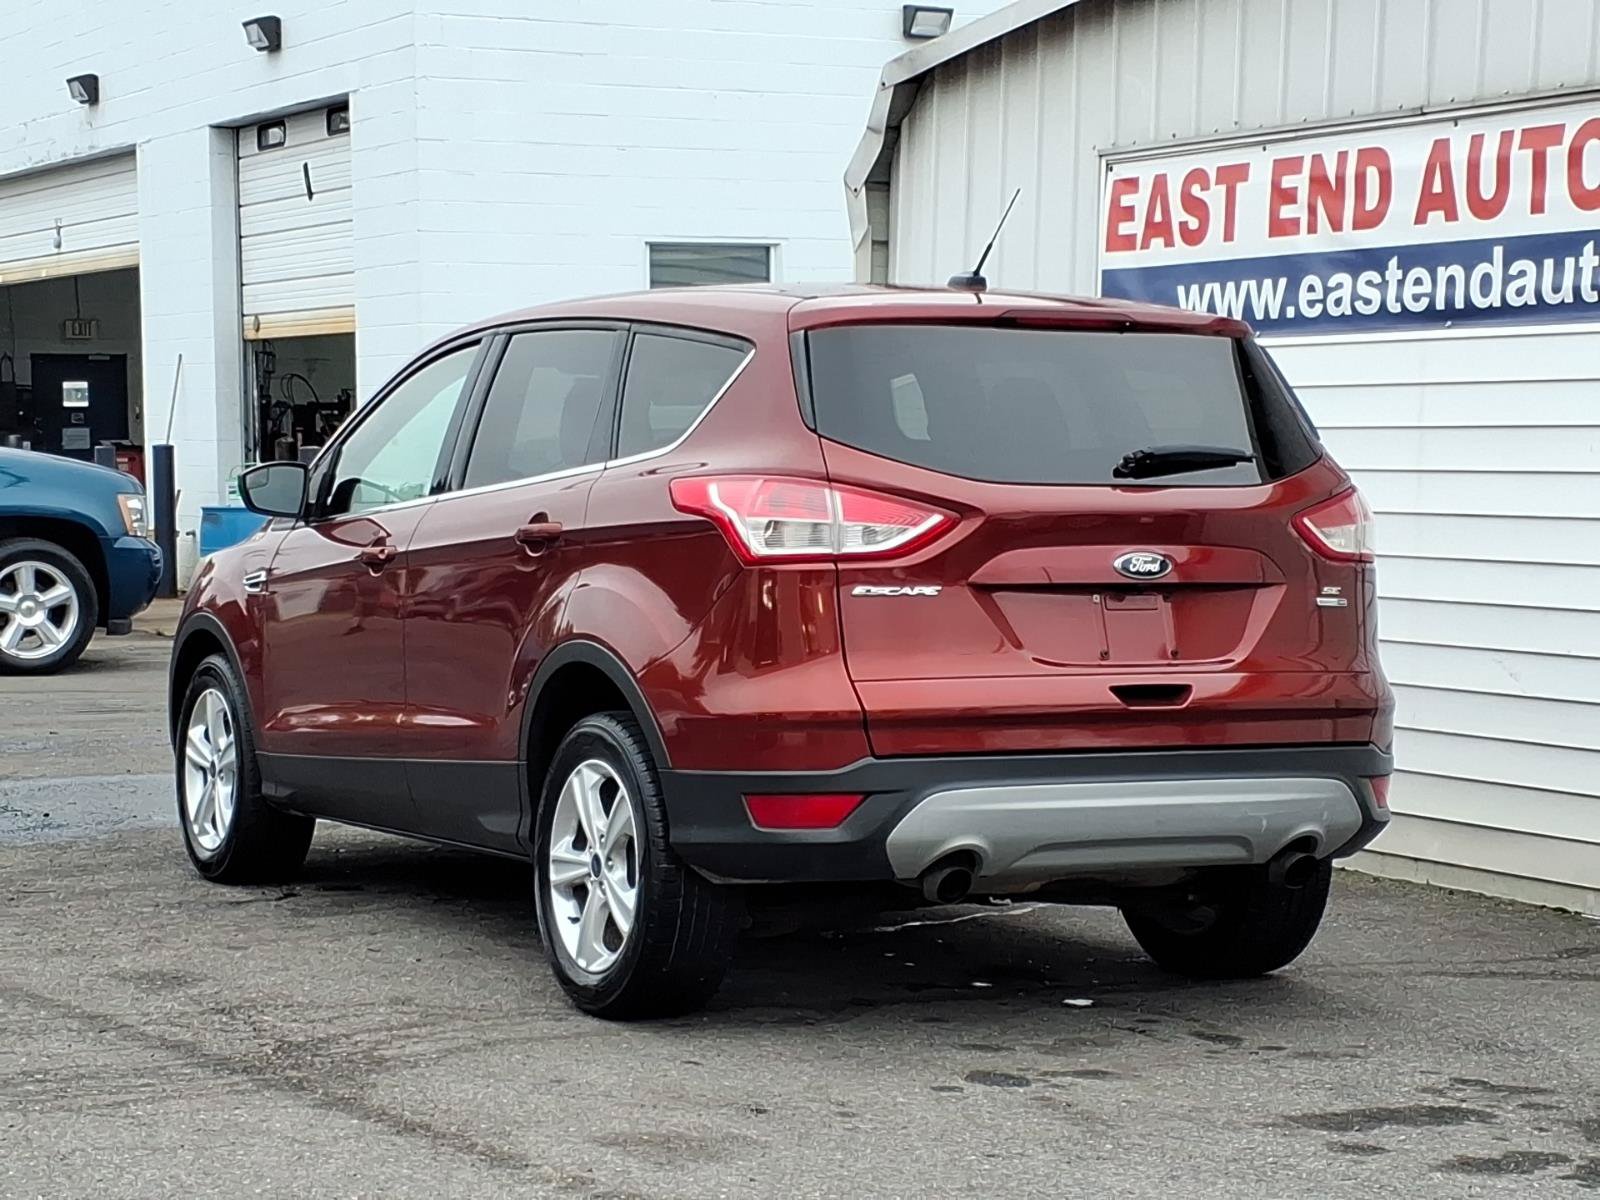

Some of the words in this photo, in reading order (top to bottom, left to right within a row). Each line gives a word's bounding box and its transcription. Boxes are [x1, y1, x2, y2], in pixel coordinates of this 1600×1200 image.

[1105, 162, 1250, 253] EAST
[1268, 146, 1393, 239] END
[71, 321, 92, 337] EXIT
[1129, 556, 1161, 573] Ford
[851, 585, 943, 596] ESCAPE
